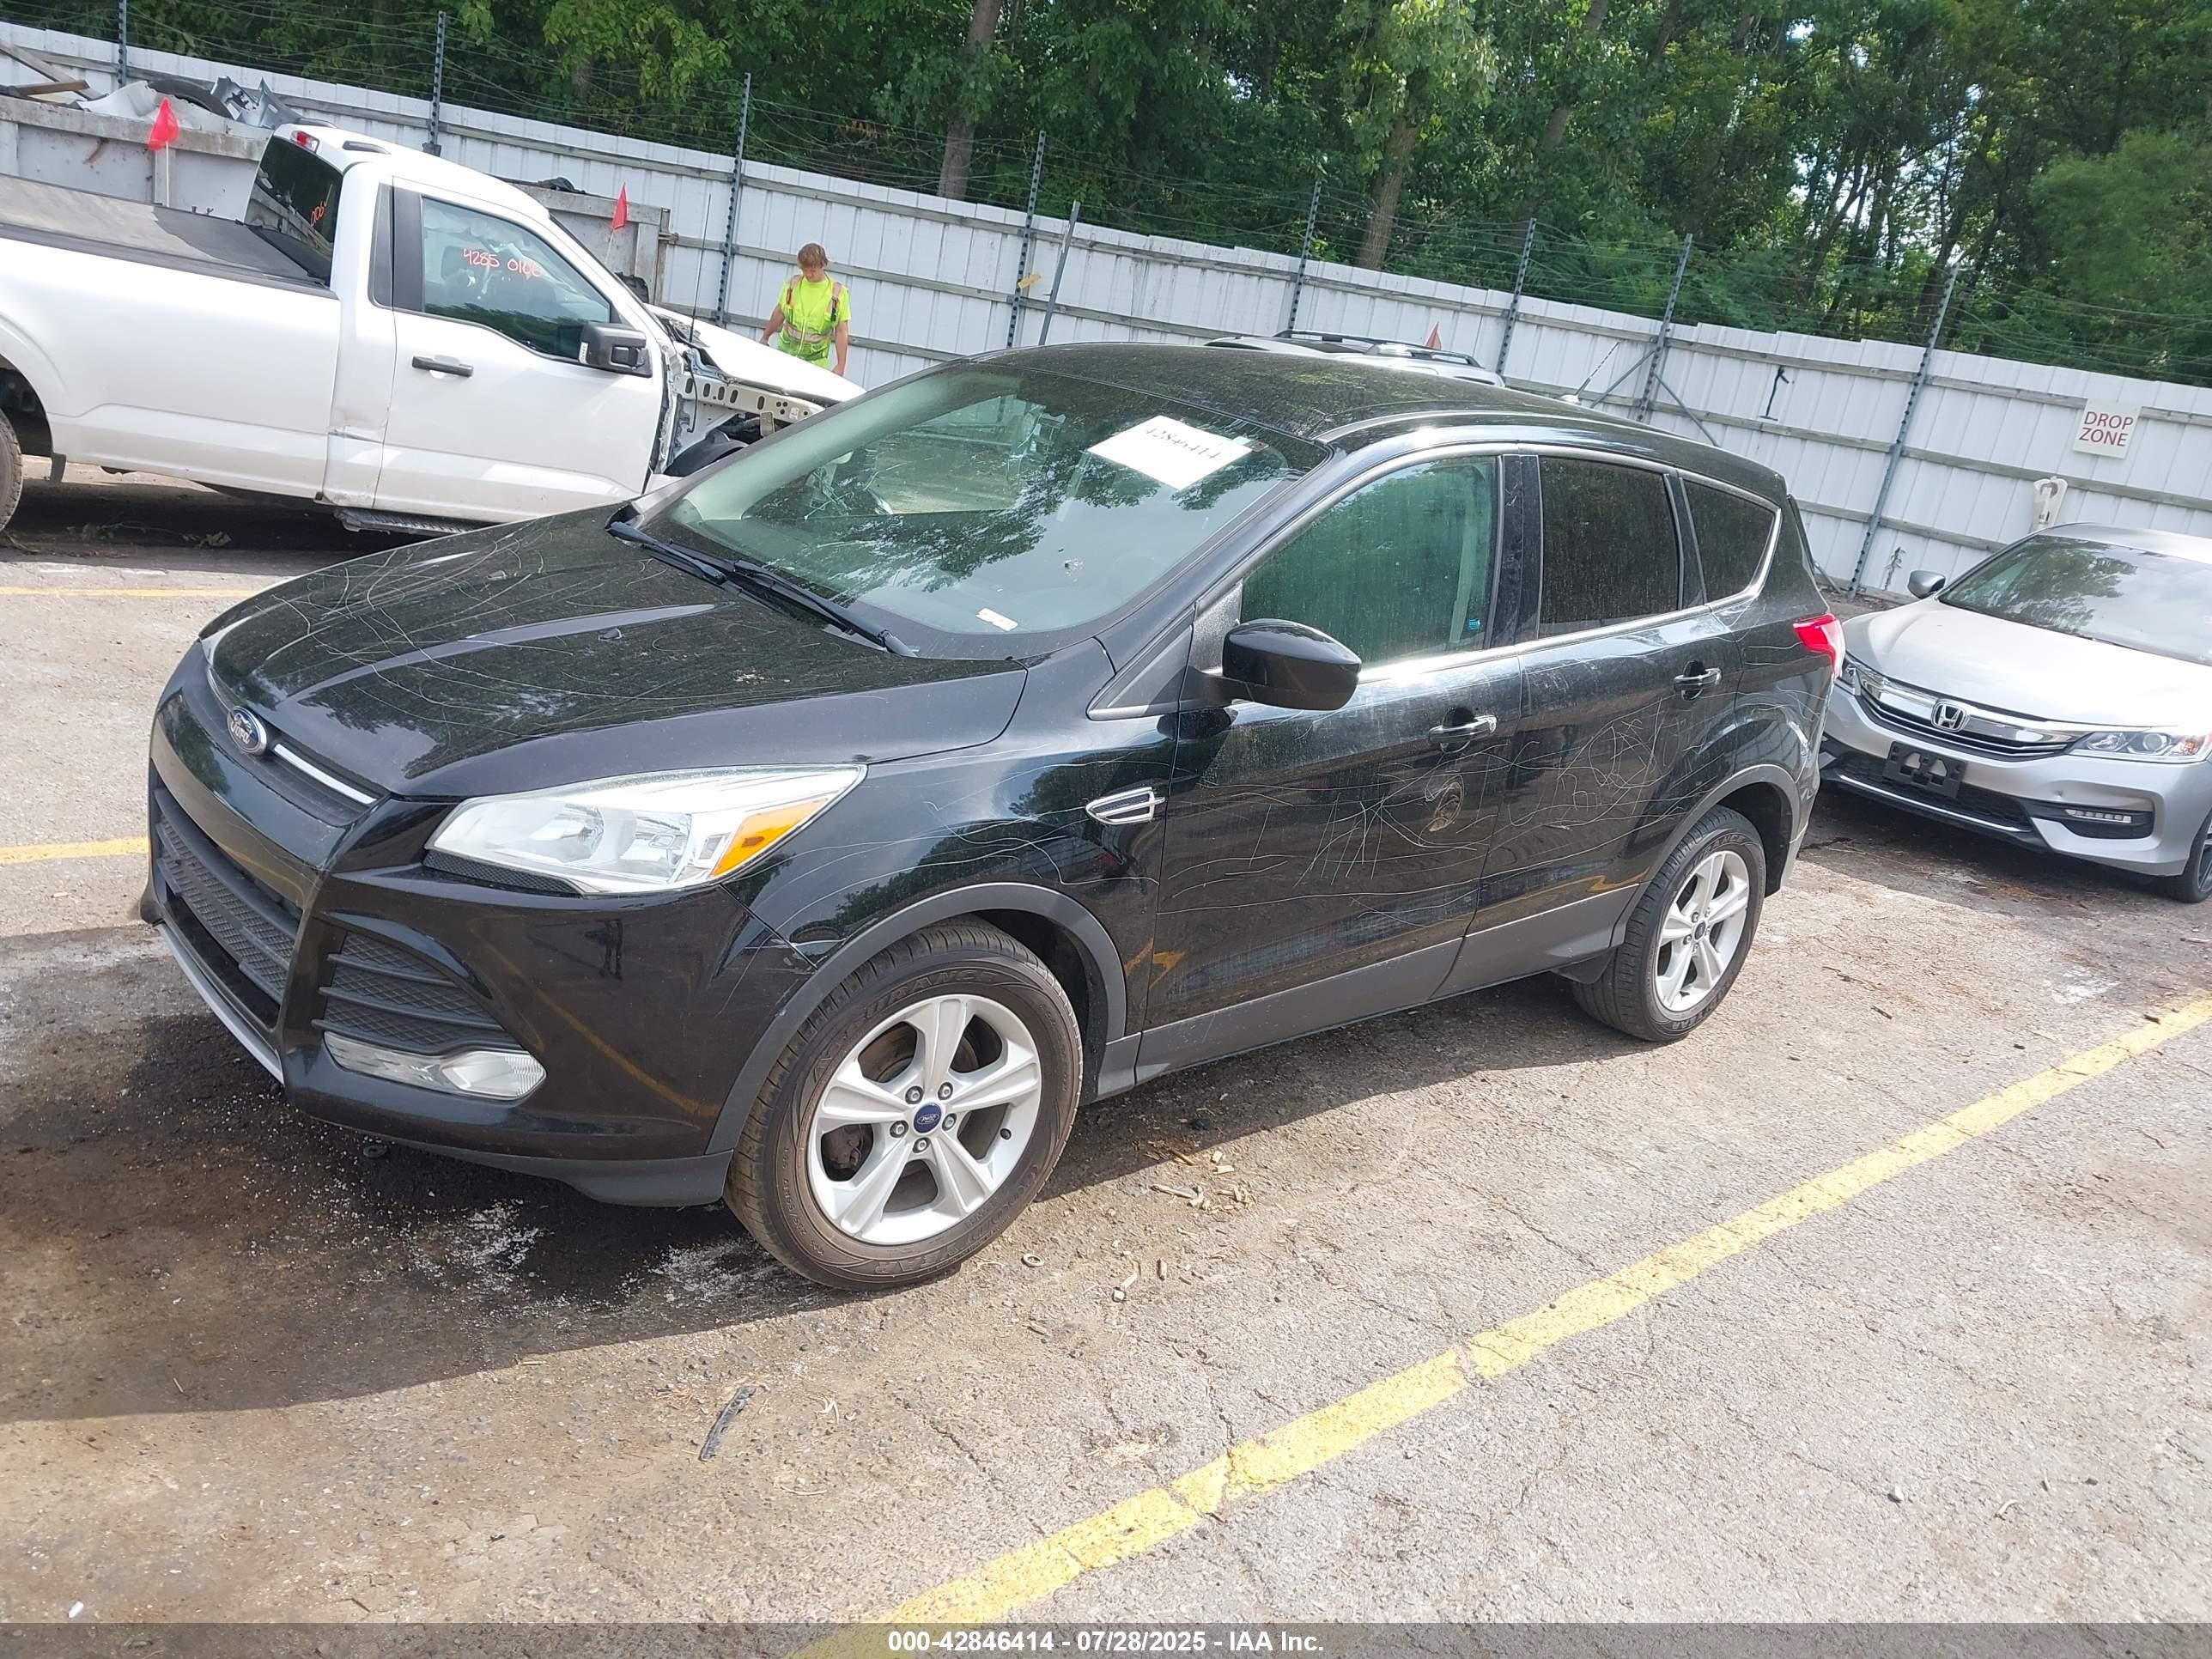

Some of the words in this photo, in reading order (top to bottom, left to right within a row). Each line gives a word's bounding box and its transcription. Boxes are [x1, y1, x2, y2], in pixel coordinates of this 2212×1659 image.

[464, 248, 500, 268] 4285
[2083, 411, 2134, 430] DROP
[2079, 427, 2129, 447] ZONE
[230, 713, 250, 744] Ford
